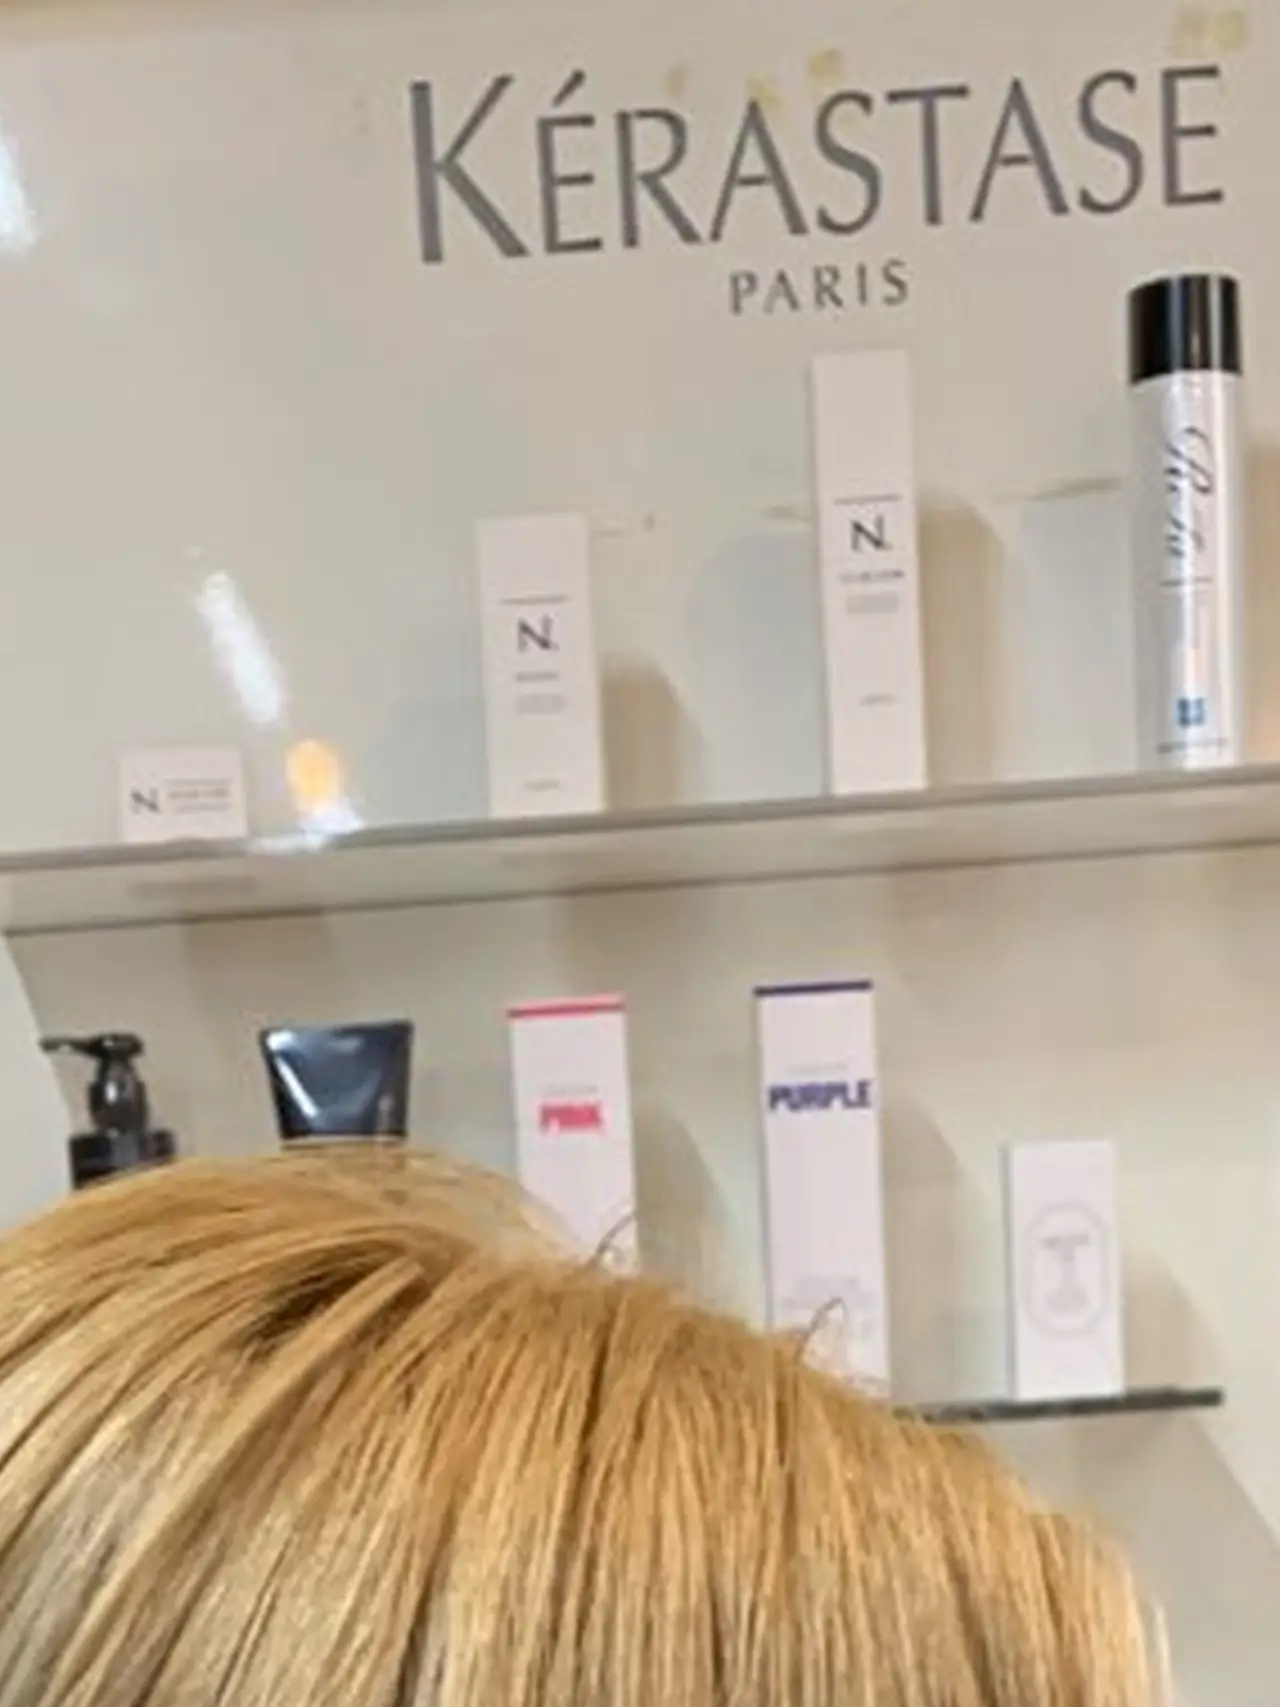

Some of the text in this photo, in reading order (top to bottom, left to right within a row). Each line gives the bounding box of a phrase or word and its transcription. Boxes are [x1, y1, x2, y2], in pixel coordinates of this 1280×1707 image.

[409, 64, 1224, 264] KÉRASTASE
[729, 259, 911, 315] PARIS
[767, 1080, 873, 1112] PURPLE
